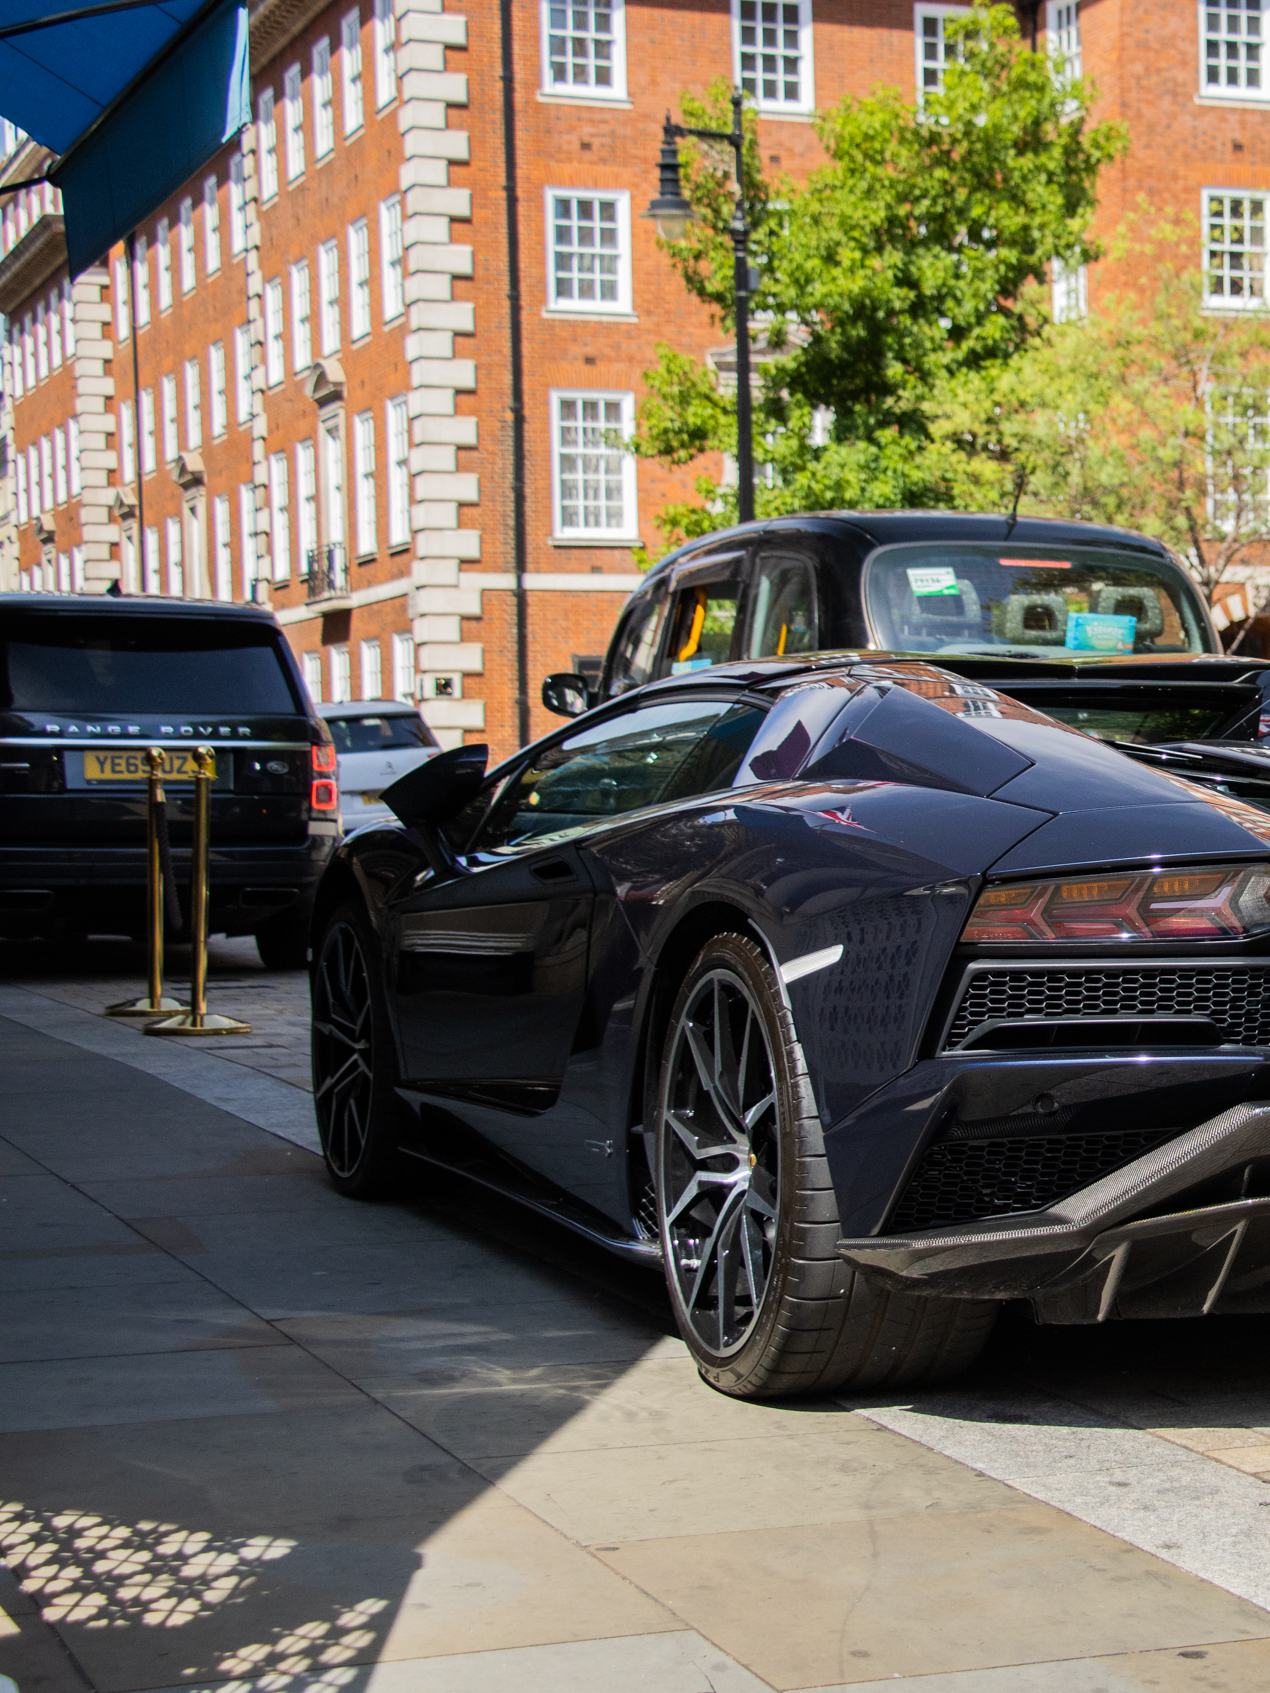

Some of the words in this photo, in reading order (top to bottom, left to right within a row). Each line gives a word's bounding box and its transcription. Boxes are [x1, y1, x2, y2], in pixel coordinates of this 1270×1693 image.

[45, 724, 142, 735] RANGE
[159, 725, 252, 736] ROVER
[160, 755, 203, 775] UZ
